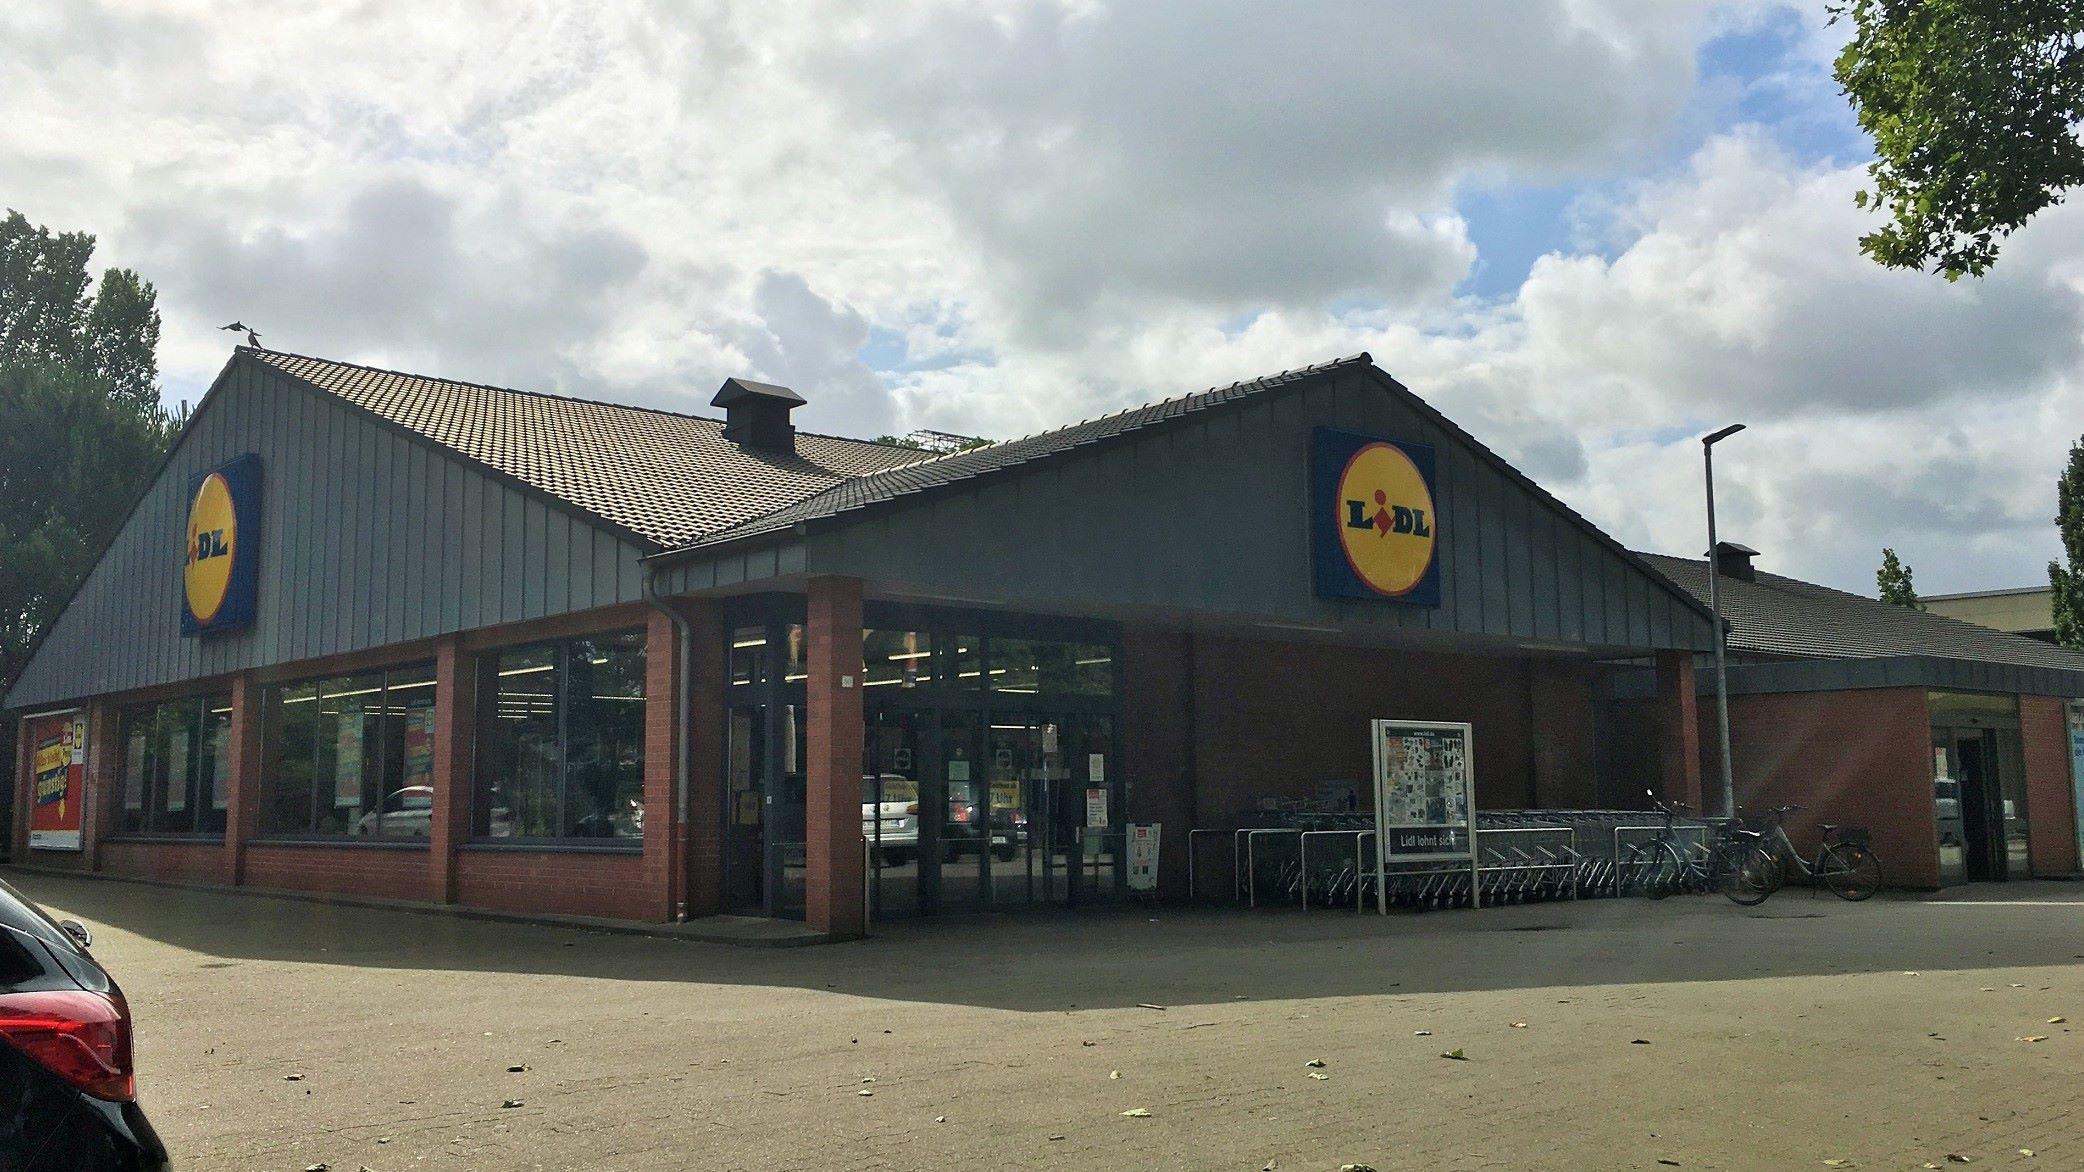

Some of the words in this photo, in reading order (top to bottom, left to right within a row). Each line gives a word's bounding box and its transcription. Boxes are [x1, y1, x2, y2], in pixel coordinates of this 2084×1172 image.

[996, 793, 1013, 803] Uhr
[1400, 834, 1416, 847] Lidl
[1417, 834, 1437, 847] lohnt
